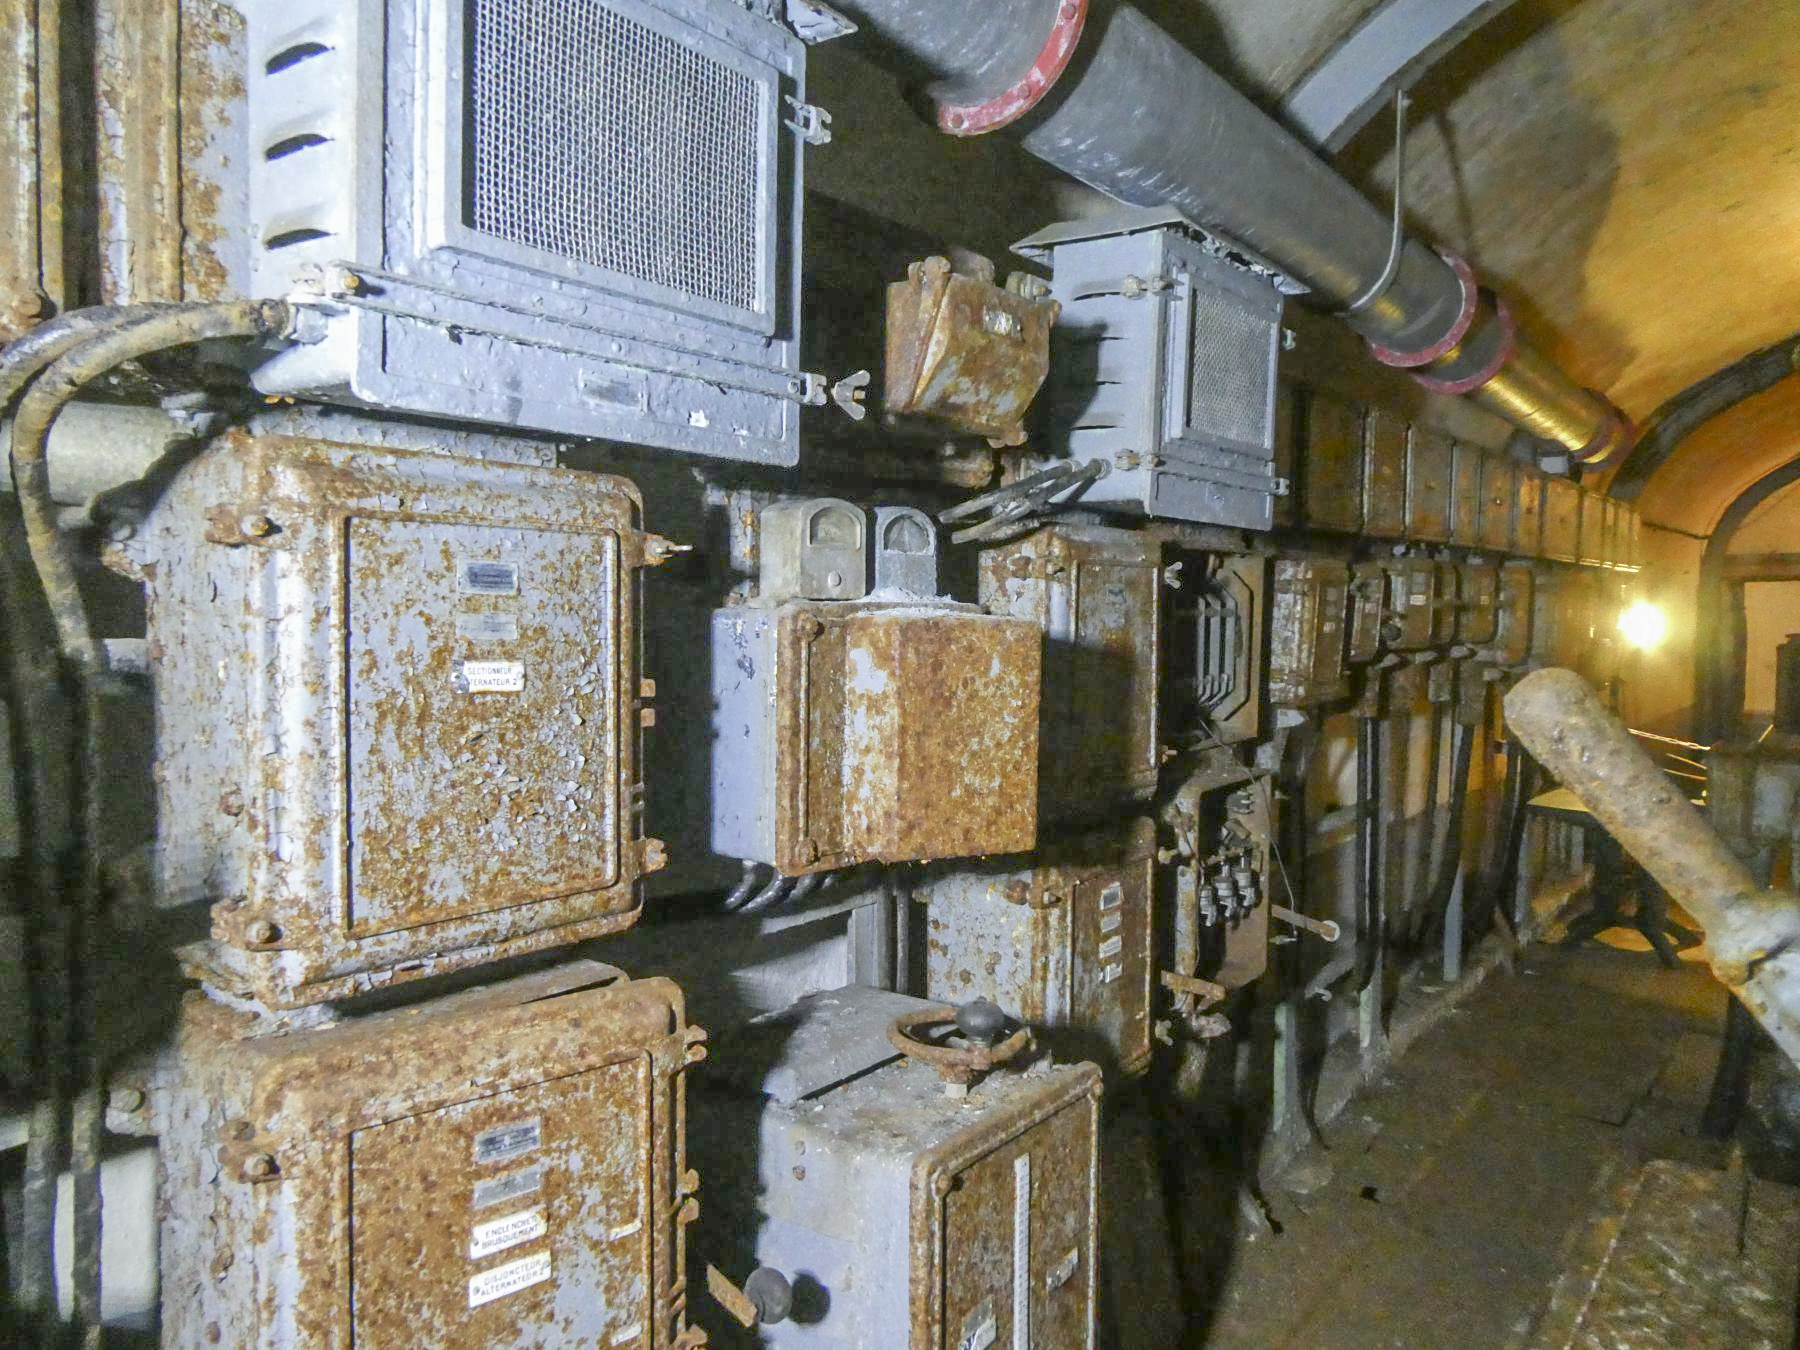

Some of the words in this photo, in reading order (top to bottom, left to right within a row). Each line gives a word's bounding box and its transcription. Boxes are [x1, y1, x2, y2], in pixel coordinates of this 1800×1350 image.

[470, 678, 510, 686] TERNATEUR
[512, 678, 517, 686] 2
[481, 1223, 538, 1250] BRUSQUEMENT
[480, 1270, 538, 1297] ALTERNATEUR
[484, 1258, 541, 1286] DISJONCTEUR
